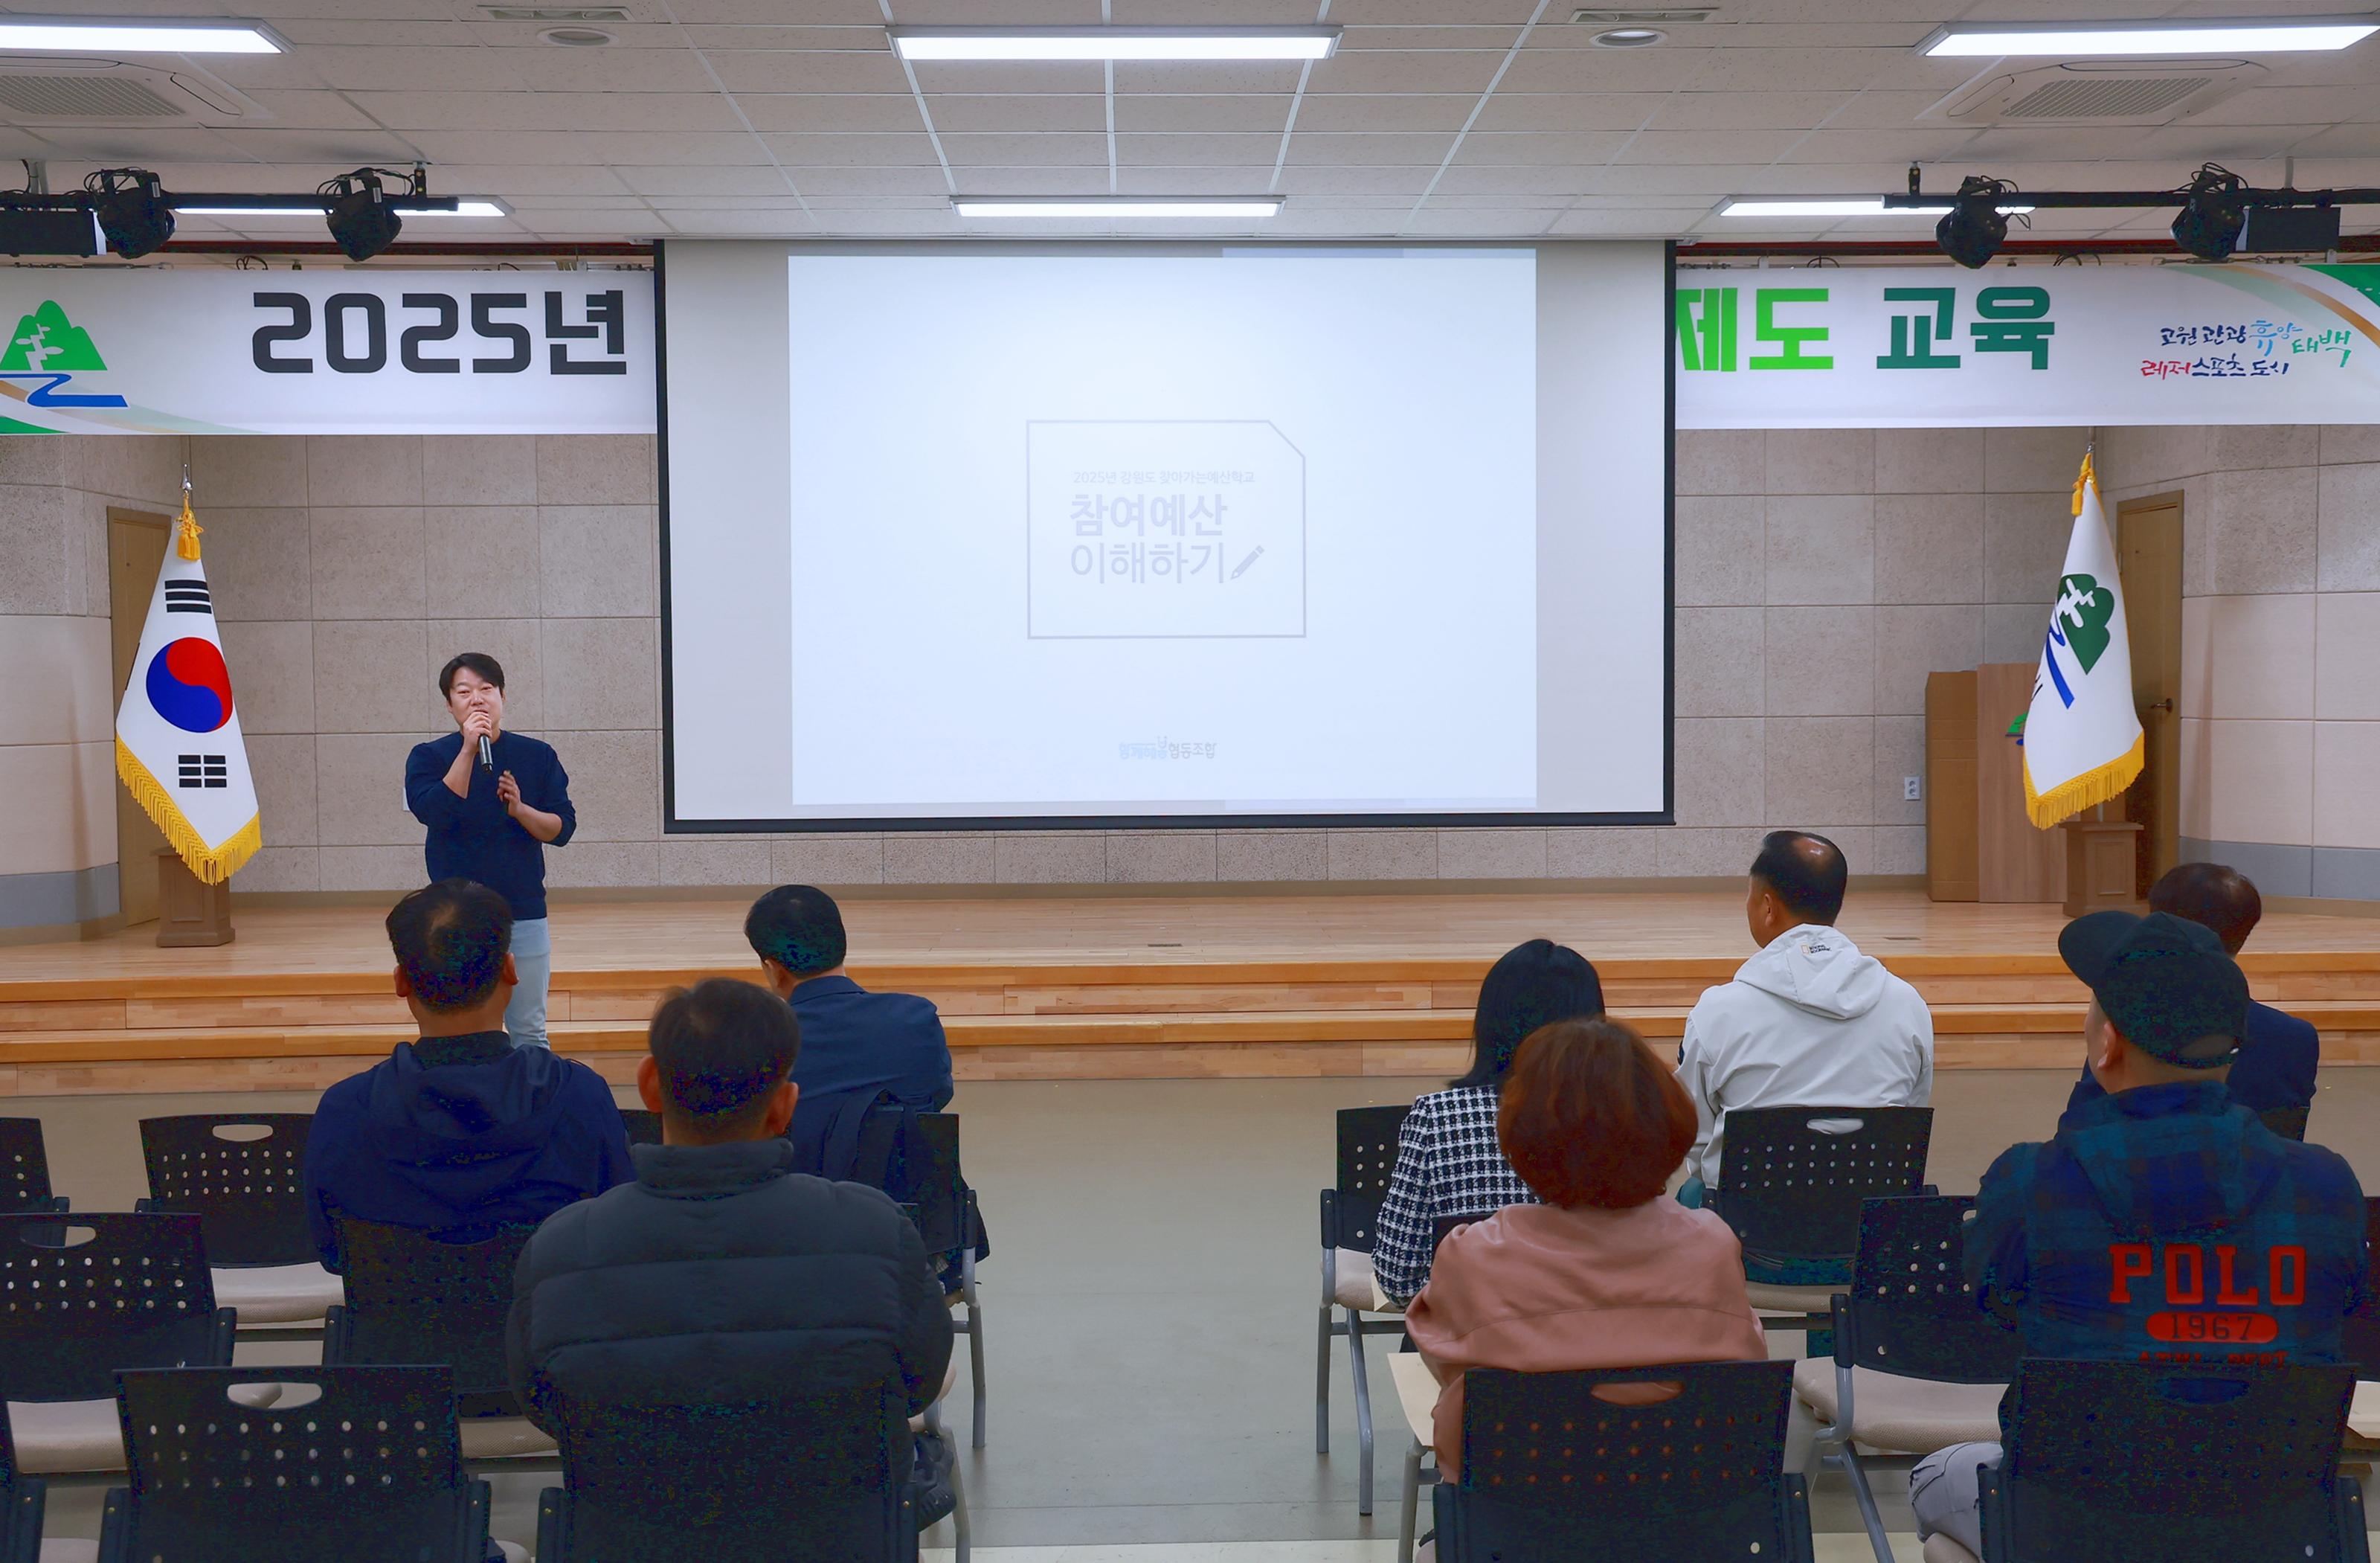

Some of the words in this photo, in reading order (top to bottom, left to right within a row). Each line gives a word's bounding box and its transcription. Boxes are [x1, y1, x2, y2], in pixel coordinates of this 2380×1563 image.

[253, 289, 627, 375] 2025년
[1876, 286, 2055, 370] 교육
[2160, 326, 2198, 346] 고원
[2248, 320, 2303, 356] 휴양
[2291, 329, 2352, 368] 태백
[1072, 470, 1117, 484] 2025년
[1119, 470, 1157, 485] 강원도
[1159, 469, 1255, 485] 찾아가는예산학교
[1070, 493, 1229, 537] 참여예산
[1070, 542, 1224, 584] 이해하기
[2108, 1243, 2306, 1306] POLO
[2171, 1314, 2254, 1341] 1967
